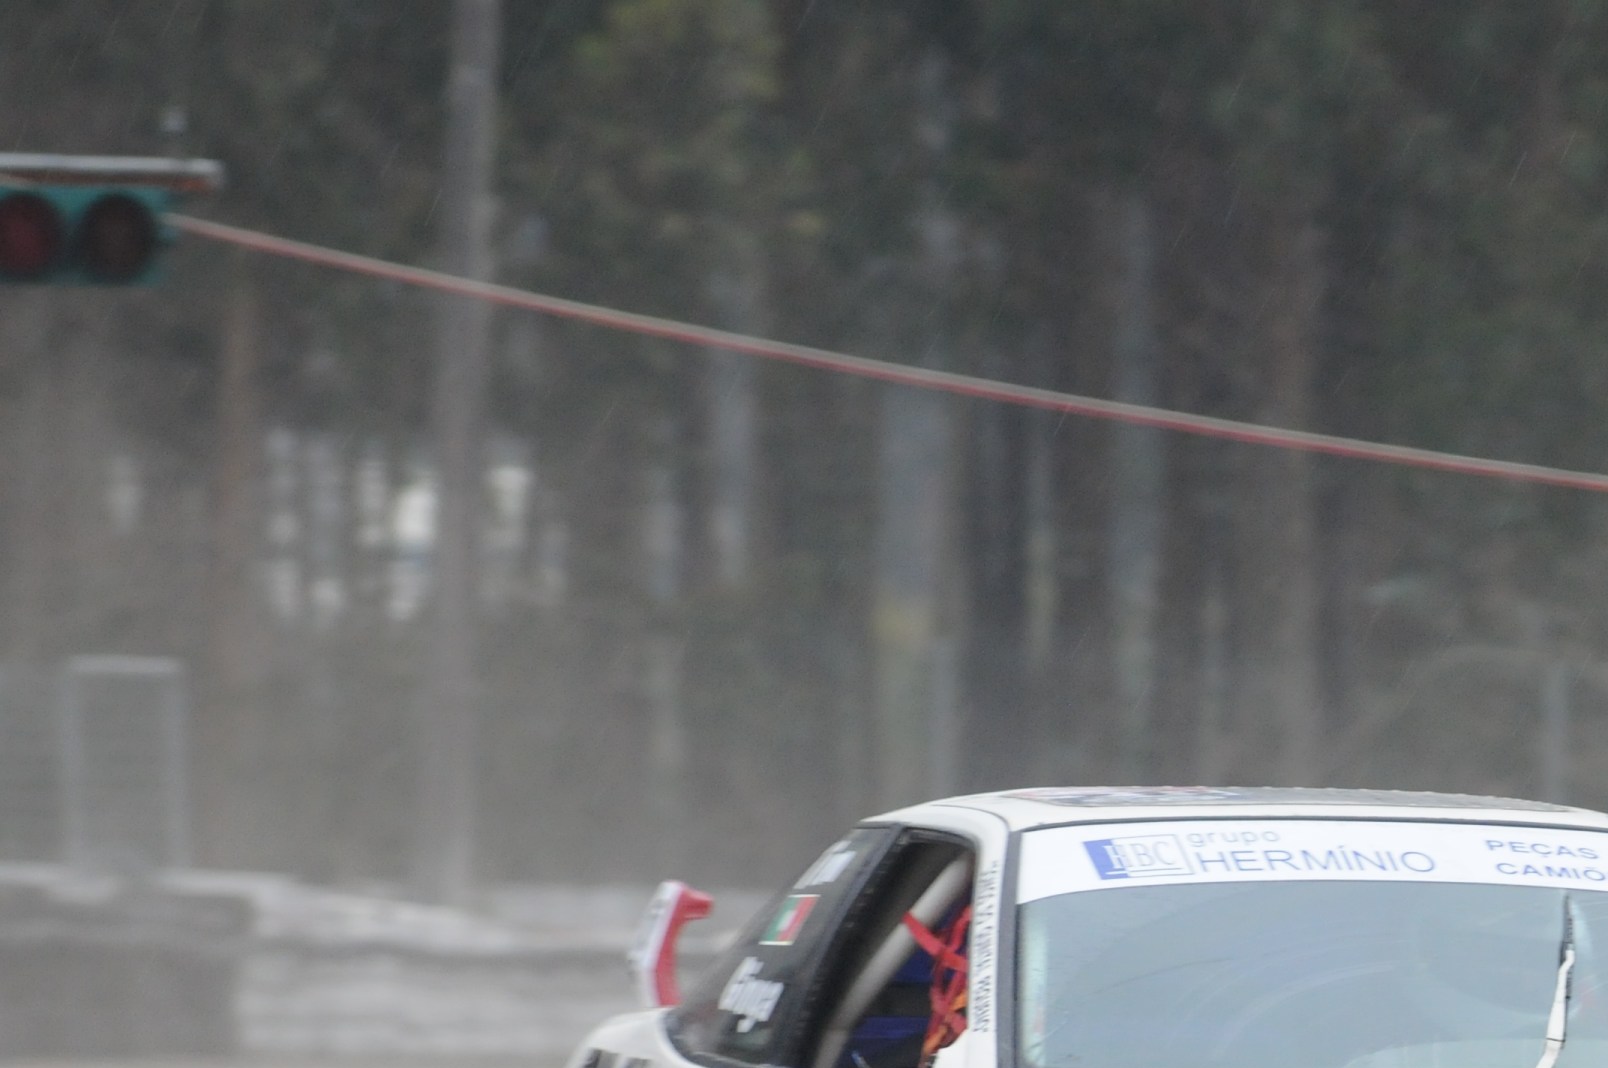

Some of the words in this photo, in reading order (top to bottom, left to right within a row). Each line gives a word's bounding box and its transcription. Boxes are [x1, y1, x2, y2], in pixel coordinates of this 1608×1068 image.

[1187, 830, 1281, 848] grupo
[1485, 839, 1599, 860] PEÇAS
[1194, 844, 1436, 873] HERMÍNIO
